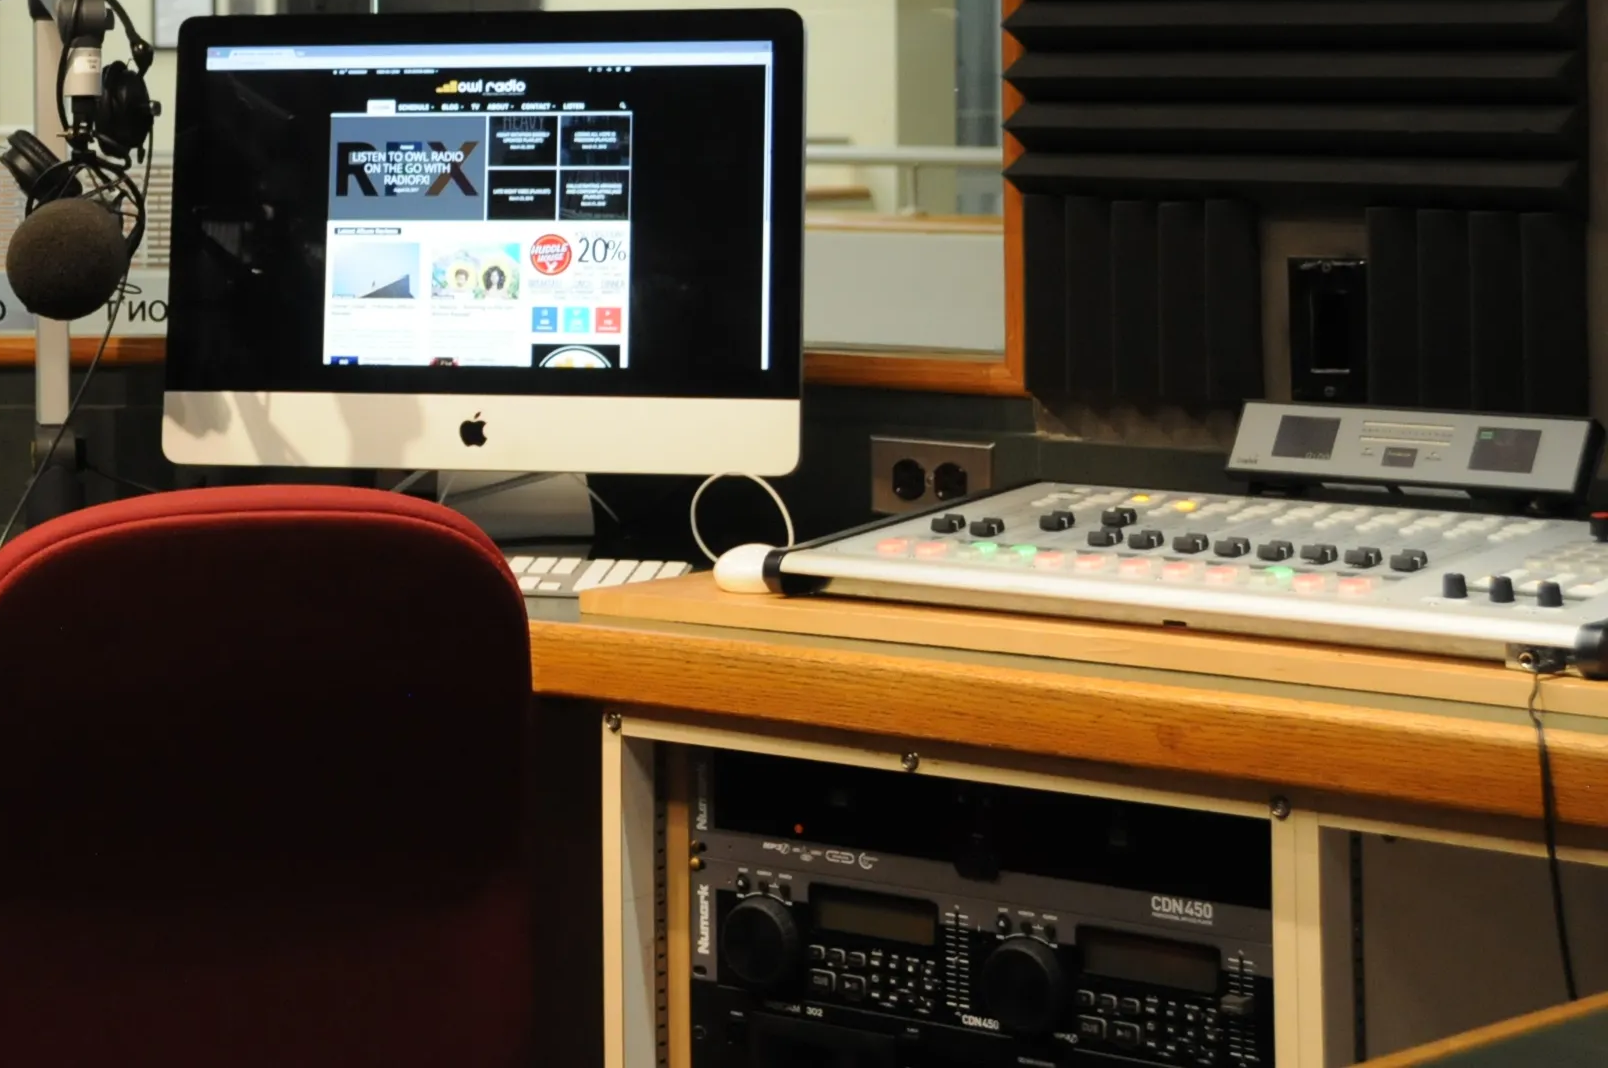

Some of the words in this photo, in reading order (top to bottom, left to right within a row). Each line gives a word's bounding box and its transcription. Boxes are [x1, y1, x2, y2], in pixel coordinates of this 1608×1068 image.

[457, 81, 483, 93] owl
[485, 79, 526, 93] radio
[352, 151, 387, 162] LISTEN
[388, 151, 403, 162] TO
[404, 151, 430, 162] OWL
[431, 151, 464, 162] RADIO
[364, 163, 381, 174] ON
[384, 163, 404, 174] THE
[405, 163, 422, 174] GO
[423, 163, 451, 174] WITH
[530, 242, 569, 255] HUDDLE
[577, 237, 627, 263] 20%
[1150, 895, 1214, 919] CDN450
[697, 883, 710, 955] Numark
[806, 1005, 824, 1019] 302
[961, 1014, 1001, 1031] CDN450
